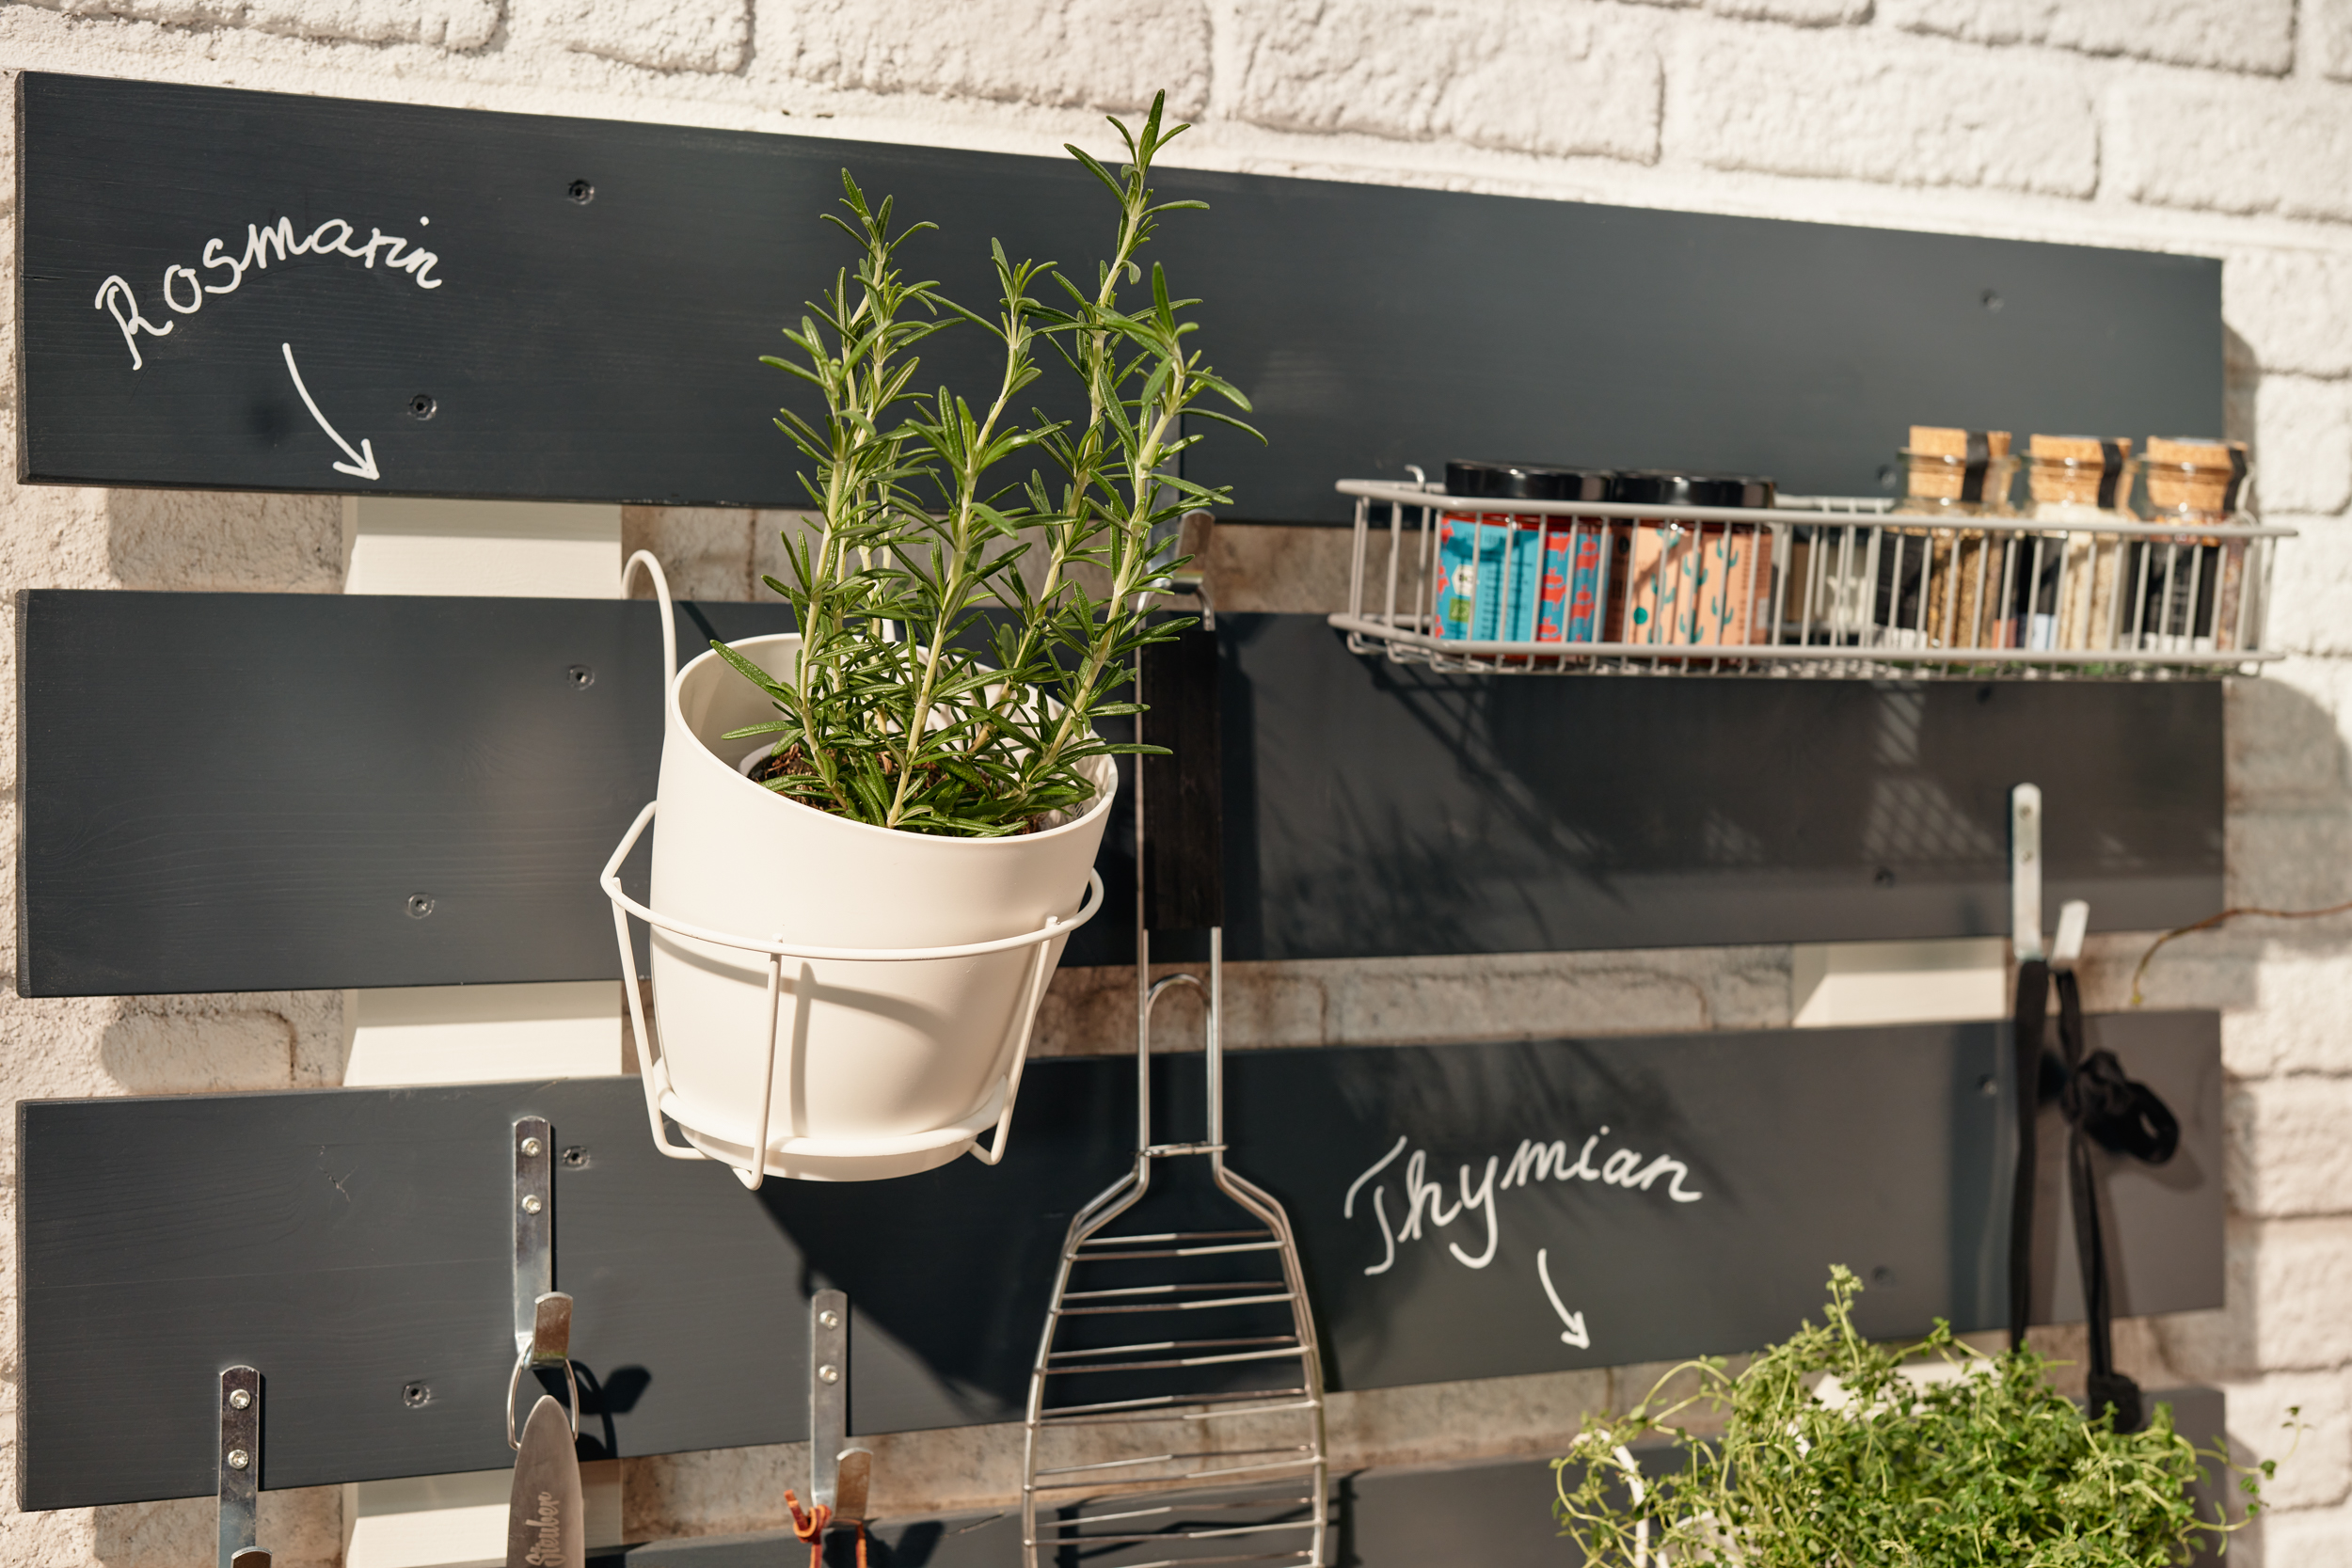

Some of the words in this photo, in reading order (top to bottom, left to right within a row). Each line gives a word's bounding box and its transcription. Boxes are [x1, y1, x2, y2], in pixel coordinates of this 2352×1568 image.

[94, 216, 443, 372] Rosmarin
[1343, 1125, 1704, 1276] Thymian
[524, 1491, 568, 1567] Steuber
